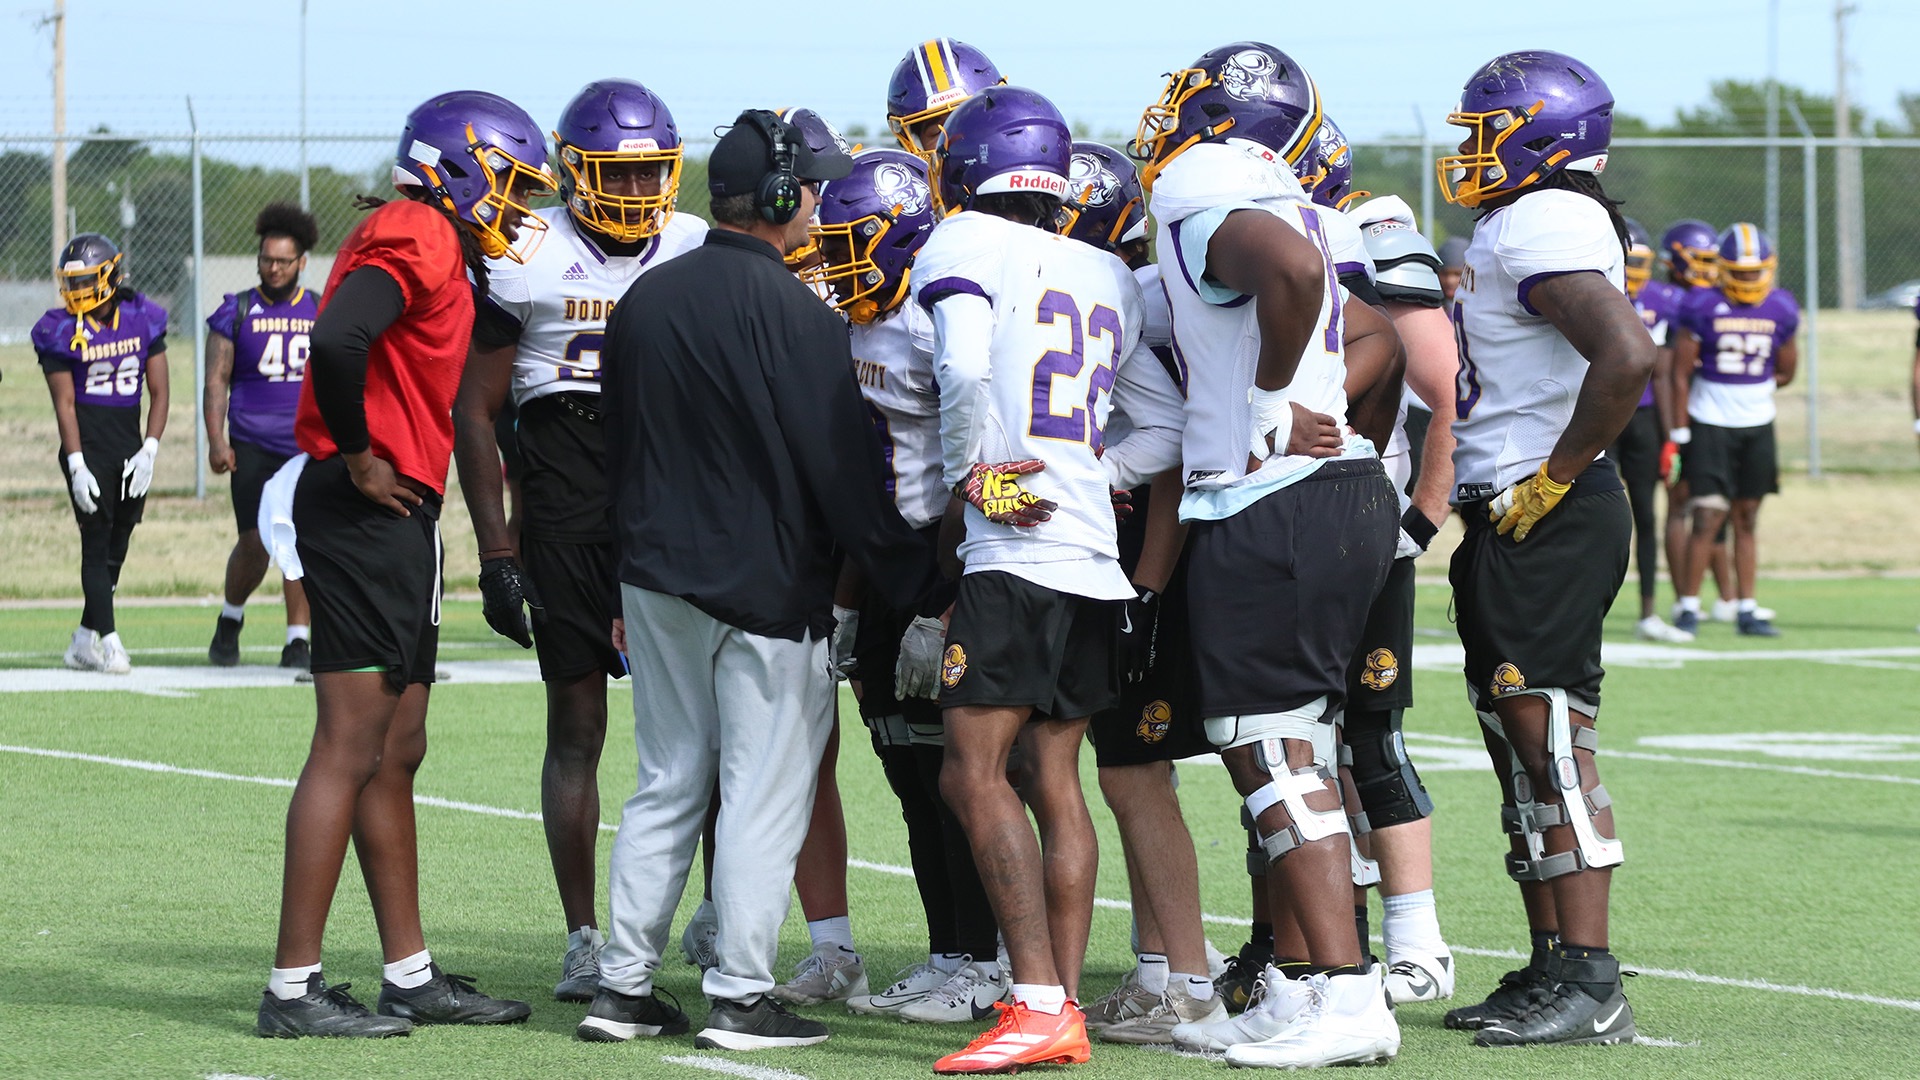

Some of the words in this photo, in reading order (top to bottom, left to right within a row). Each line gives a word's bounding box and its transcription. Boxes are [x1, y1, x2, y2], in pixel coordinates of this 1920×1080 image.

[1009, 174, 1066, 195] Riddell
[562, 272, 589, 281] adidas
[564, 298, 617, 322] DODG
[257, 333, 311, 382] 49
[1716, 333, 1773, 376] 27
[859, 360, 887, 390] CITY
[1027, 288, 1123, 458] 22
